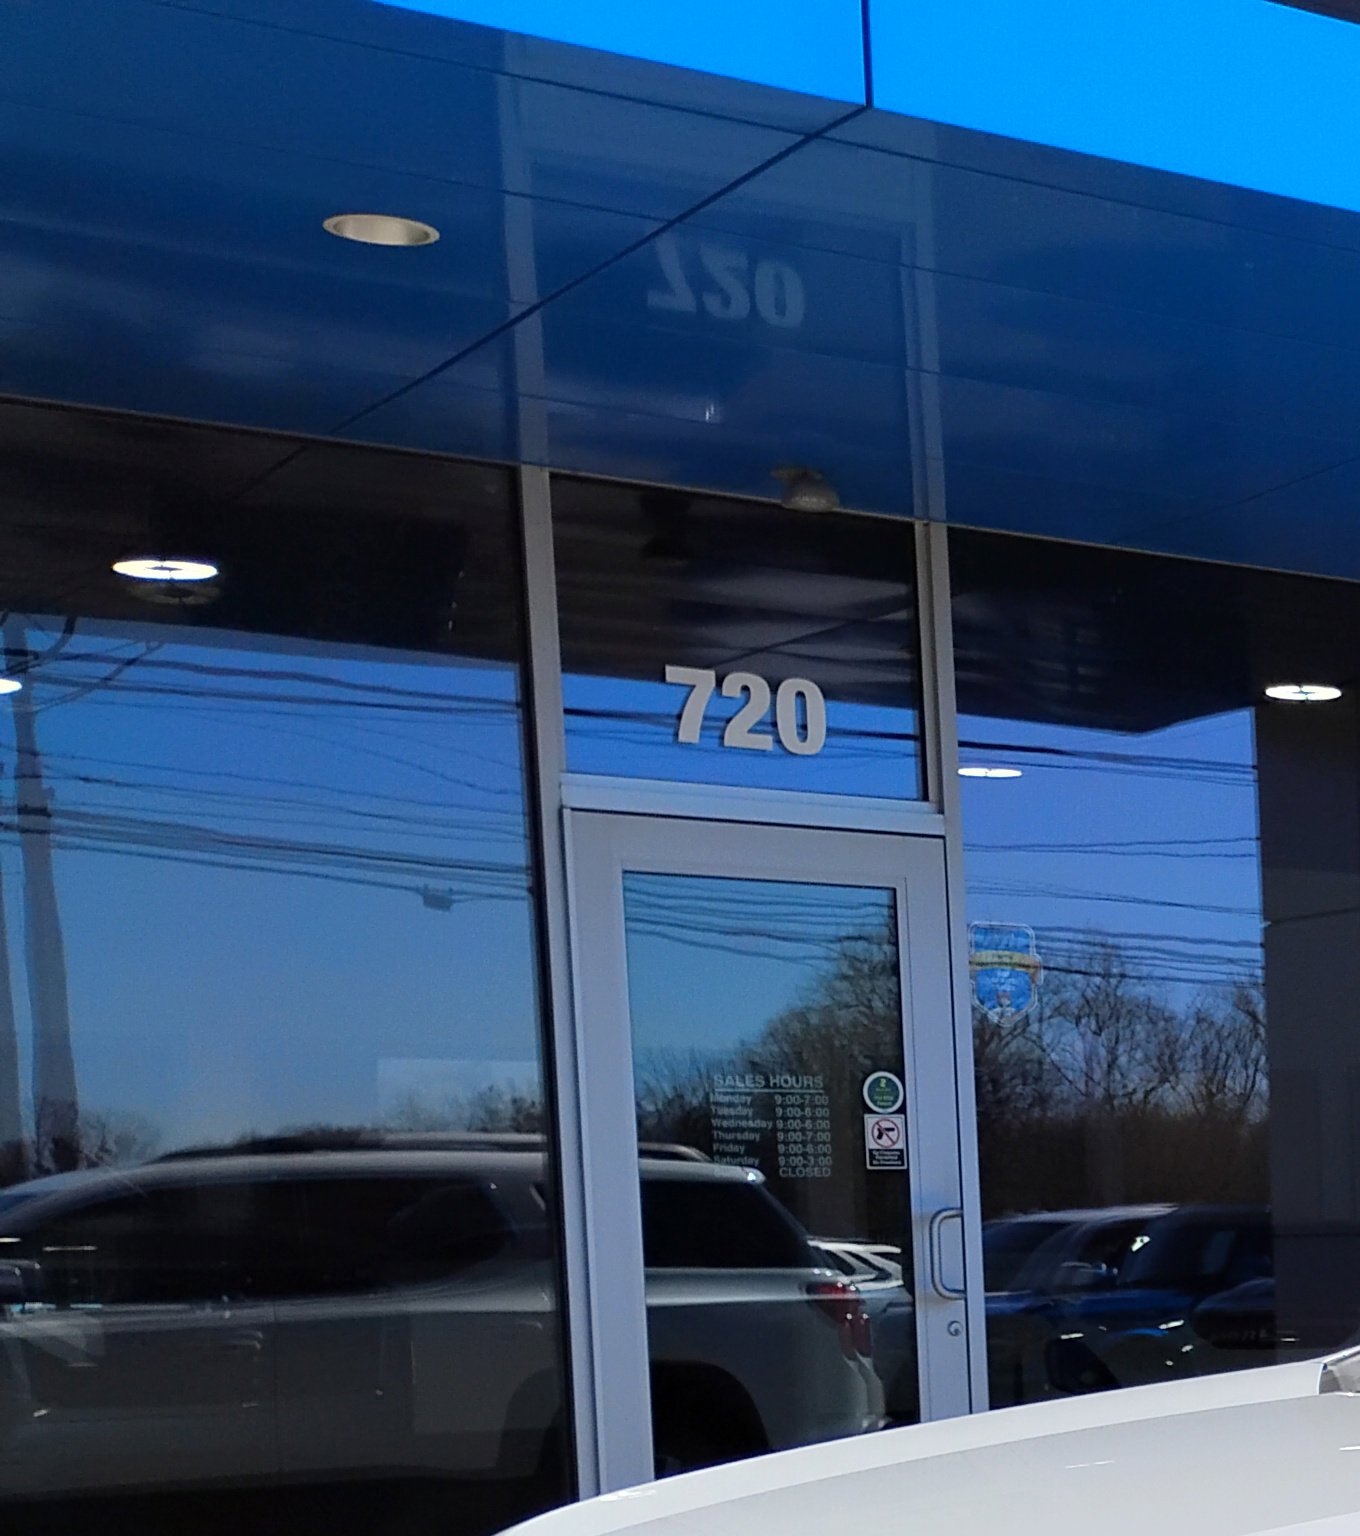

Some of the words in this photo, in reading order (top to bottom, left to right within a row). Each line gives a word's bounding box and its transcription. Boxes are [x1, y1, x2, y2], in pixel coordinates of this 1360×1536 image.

[665, 664, 827, 755] 720
[713, 1074, 765, 1088] SALES
[769, 1075, 824, 1088] HOURS
[709, 1093, 752, 1105] Monday
[774, 1095, 829, 1105] 9:00-7:00
[711, 1105, 753, 1117] Tuesday
[711, 1119, 773, 1130] Wednesday
[712, 1130, 761, 1142] Thursday
[776, 1131, 831, 1142] 9:00-7:00
[712, 1143, 746, 1154] Friday
[713, 1156, 760, 1167] Saturday
[779, 1167, 832, 1178] CLOSED
